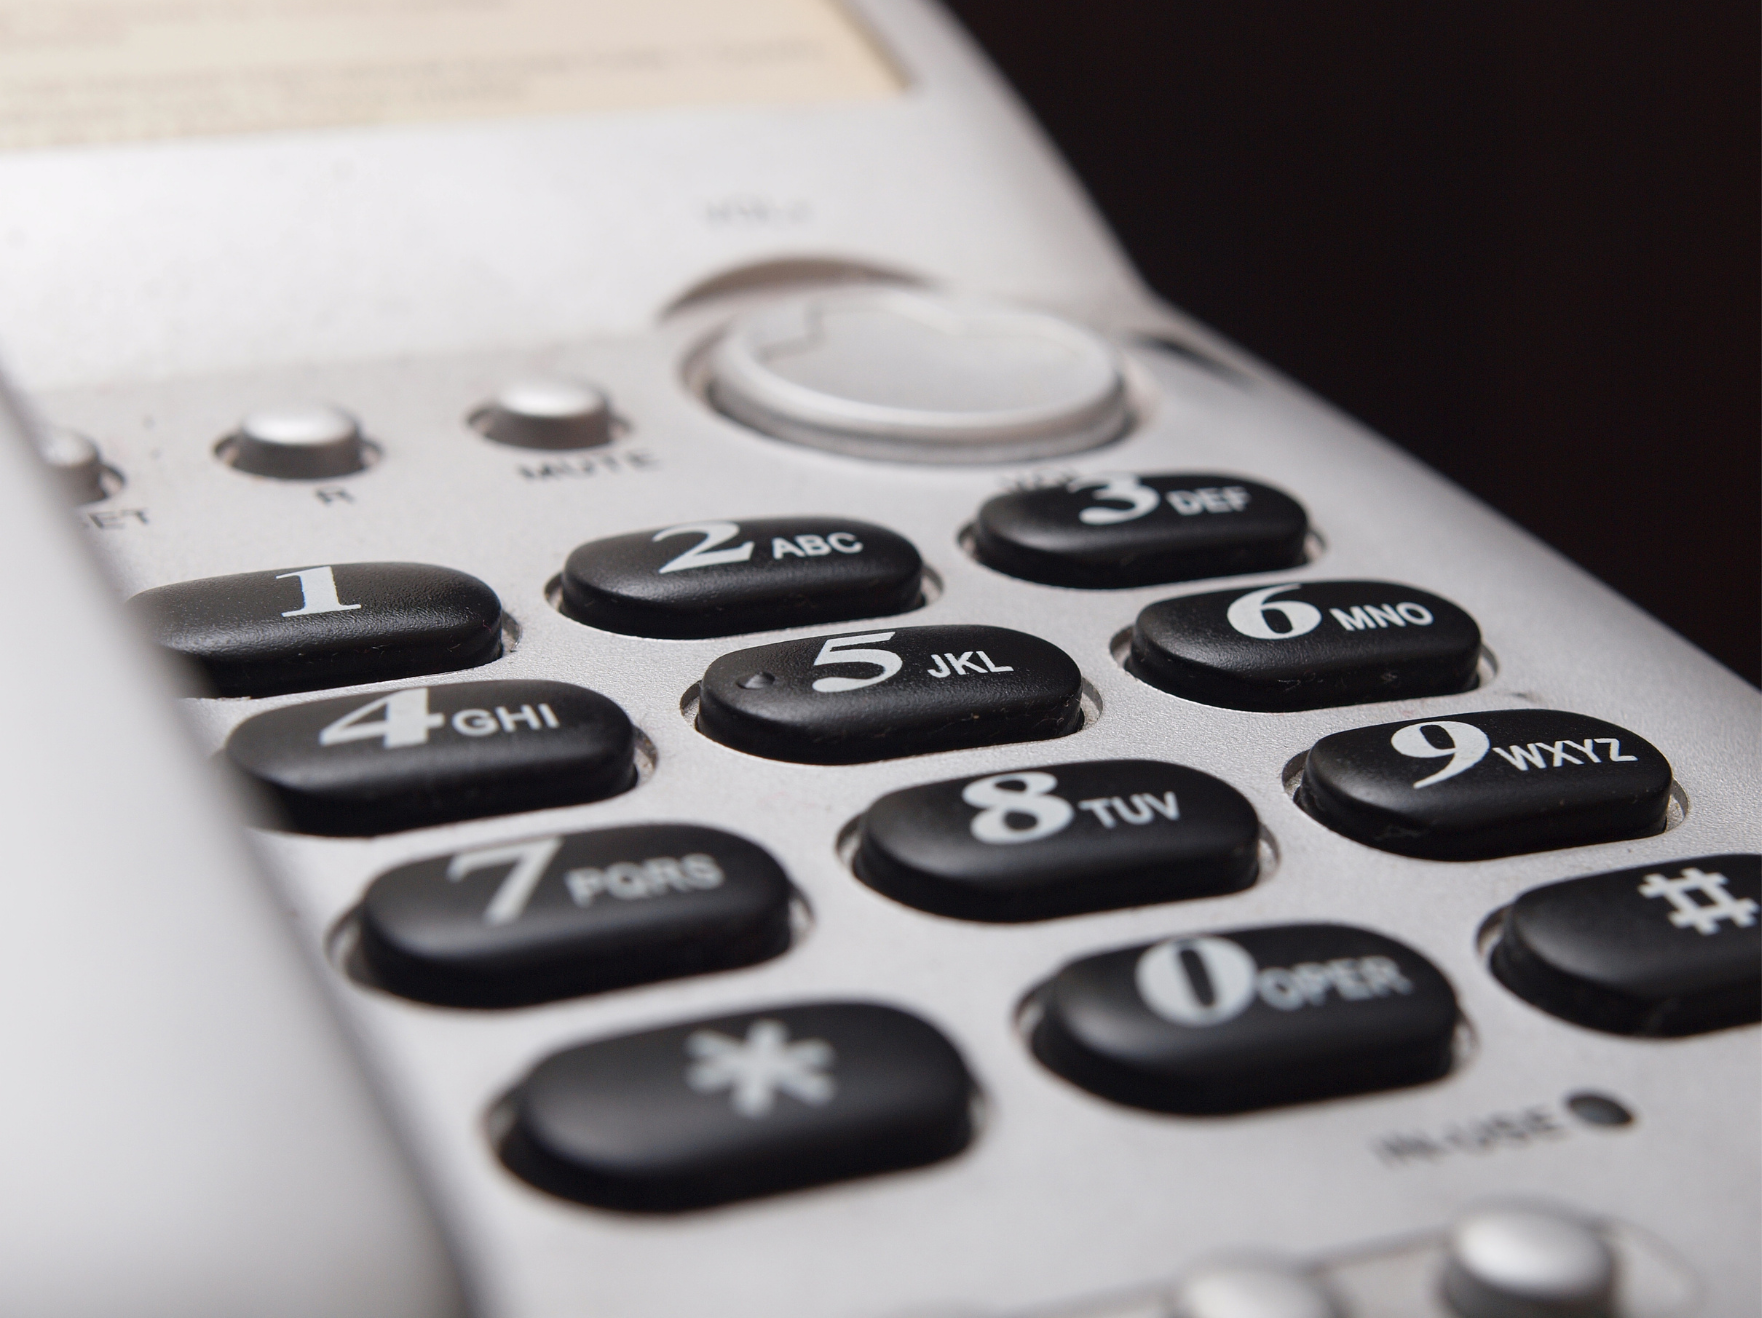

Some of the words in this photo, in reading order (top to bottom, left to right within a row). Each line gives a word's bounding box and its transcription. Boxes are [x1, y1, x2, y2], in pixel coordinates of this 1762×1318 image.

[314, 487, 356, 506] R
[516, 452, 658, 482] MUTE
[1066, 474, 1161, 525] 3
[1167, 485, 1251, 516] DEF
[652, 521, 753, 574] 2
[771, 531, 864, 560] ABC
[276, 565, 362, 618] 1
[1227, 583, 1322, 640] 6
[1329, 602, 1433, 633] MNO
[811, 631, 903, 693] 5
[926, 650, 1014, 678] JKL
[318, 686, 446, 749] 4
[451, 702, 560, 738] GHI
[1391, 721, 1490, 790] 9
[1492, 737, 1639, 772] WXYZ
[962, 771, 1074, 844] 8
[1079, 791, 1181, 829] TUV
[447, 834, 563, 924] 7
[566, 852, 726, 908] PQRS
[1637, 866, 1759, 936] #
[1135, 936, 1257, 1026] 0
[1255, 954, 1412, 1011] OPER
